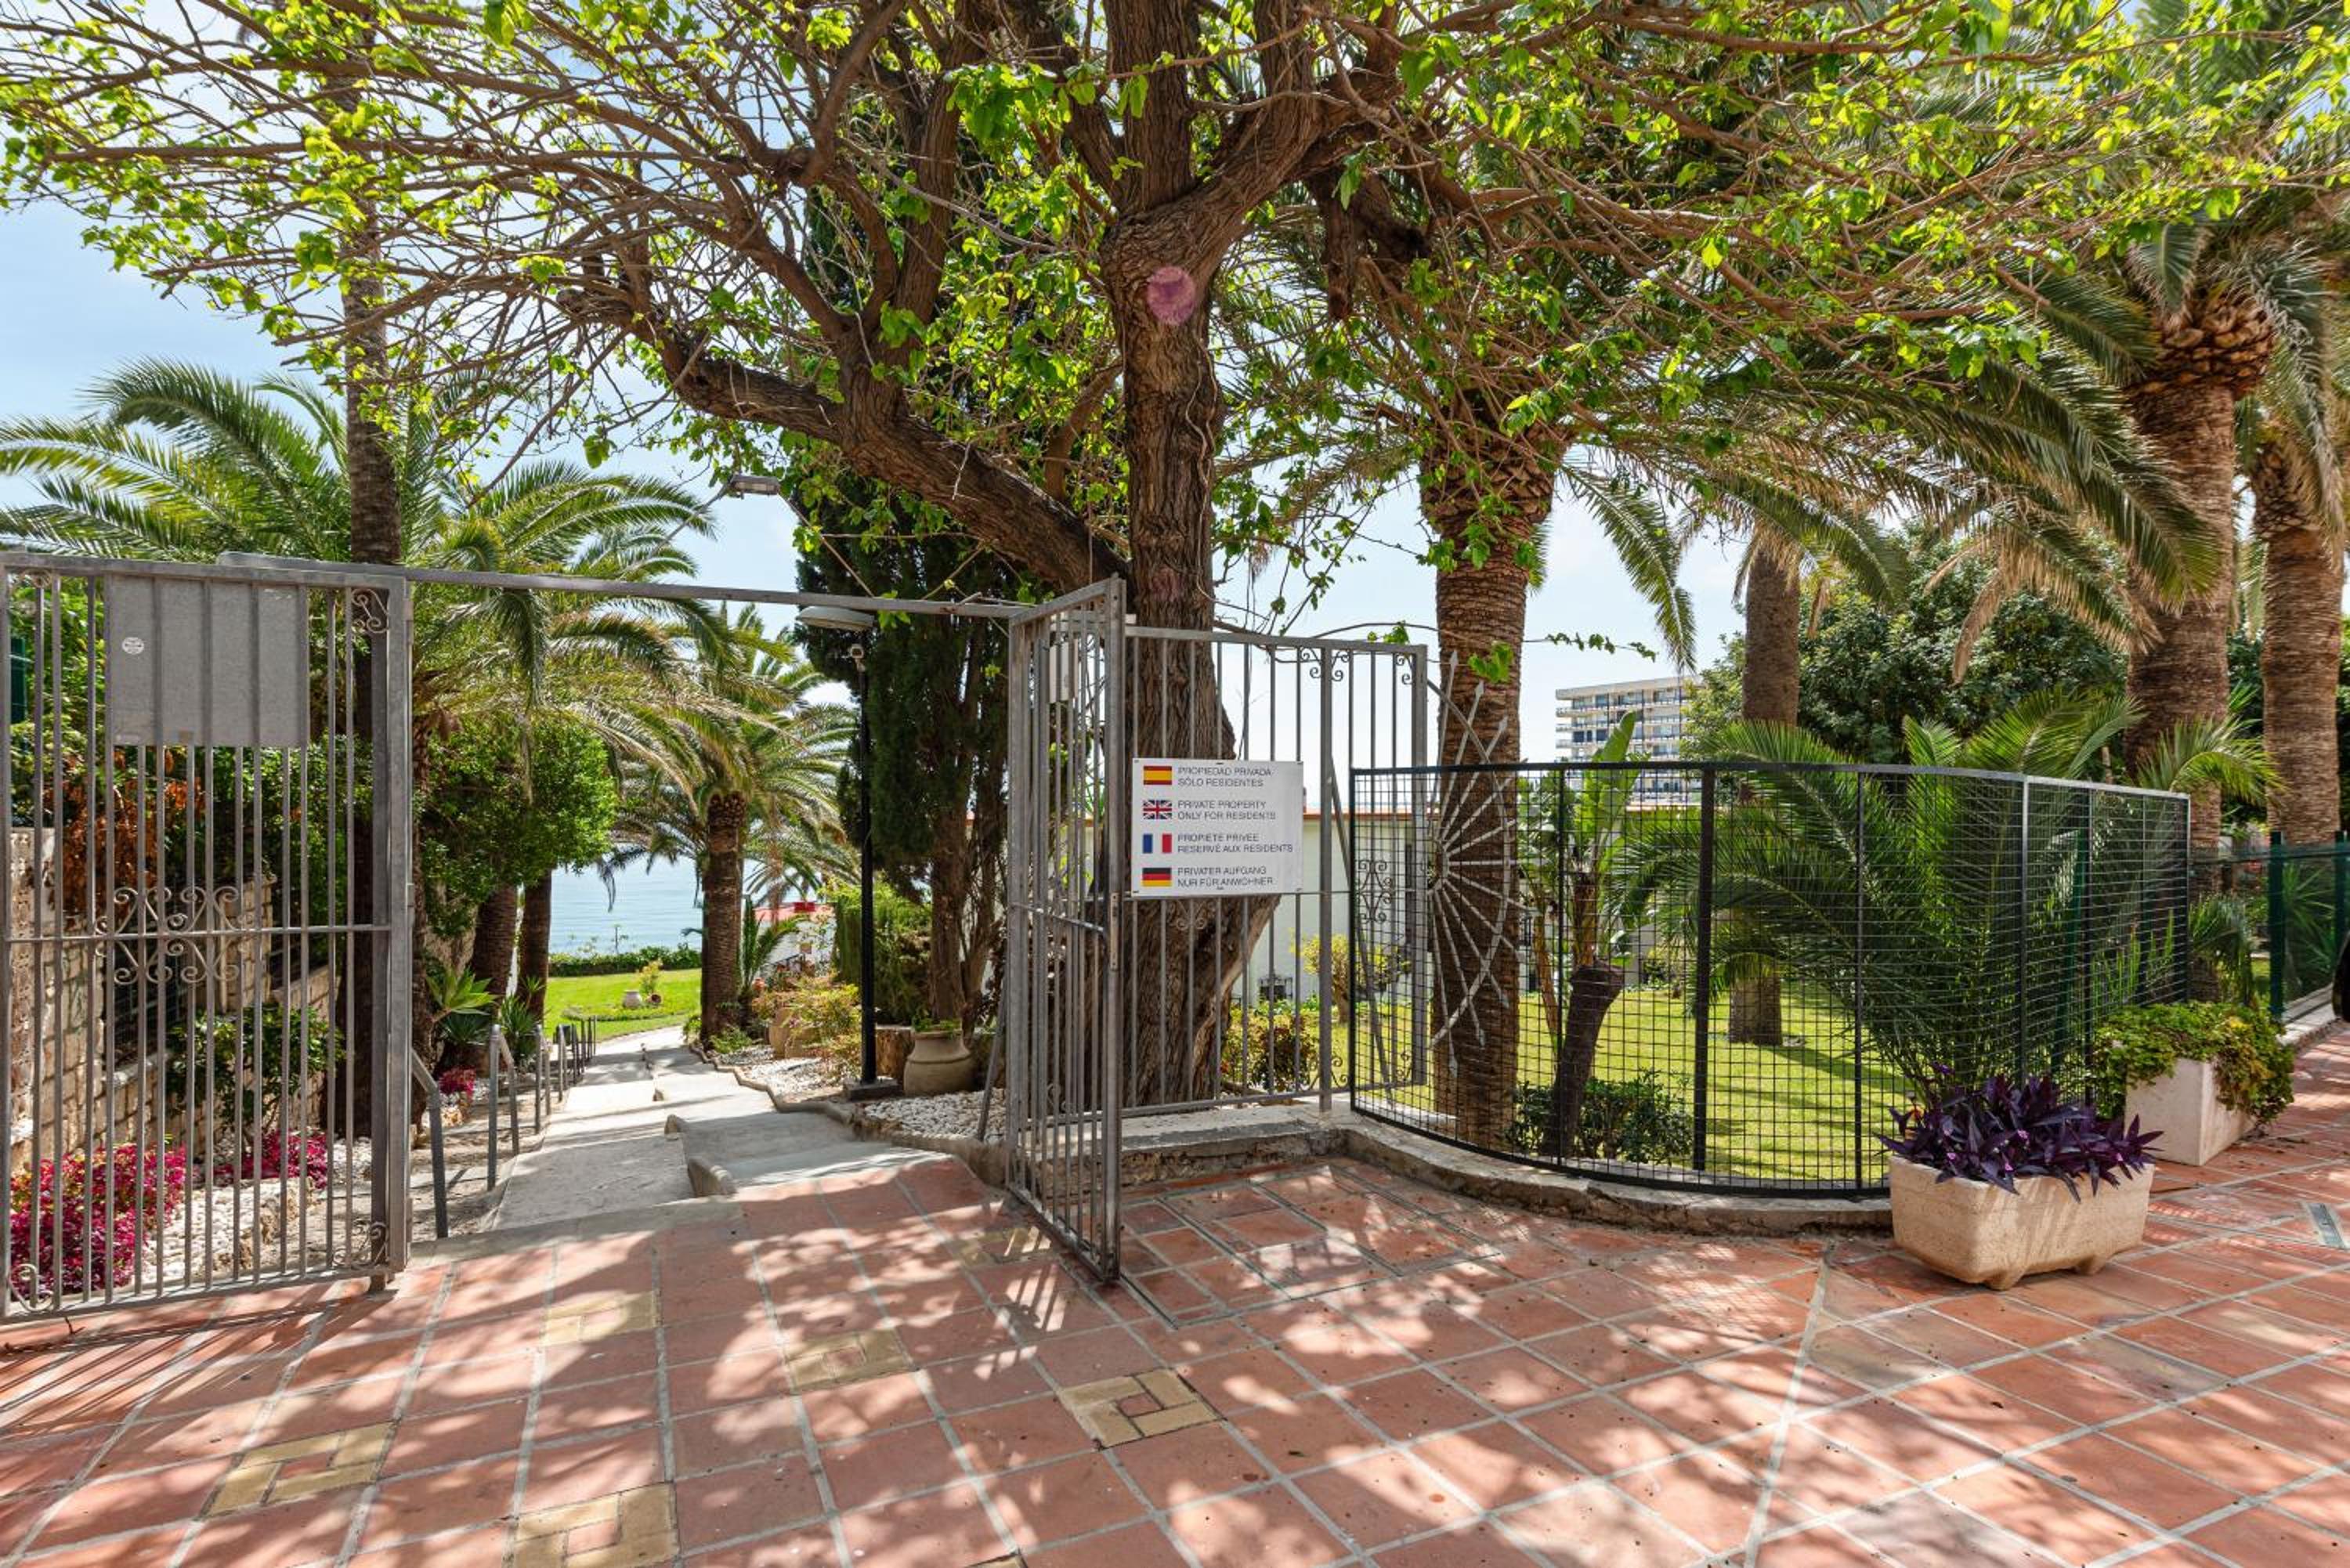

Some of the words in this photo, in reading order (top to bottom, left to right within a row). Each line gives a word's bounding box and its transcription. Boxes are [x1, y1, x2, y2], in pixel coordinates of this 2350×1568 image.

[1177, 766, 1232, 776] PROPIEDAD
[1234, 767, 1271, 776] PRIVADA
[1206, 778, 1264, 787] RESIDENTES
[1177, 800, 1215, 809] PRIVATE
[1218, 800, 1267, 809] PROPERTY
[1177, 811, 1202, 820] ONLY
[1204, 811, 1223, 820] FOR
[1226, 811, 1276, 820] RESIDENTS
[1223, 844, 1242, 853] AUX
[1243, 844, 1293, 853] RESIDENTS
[1177, 867, 1221, 876] PRIVATER
[1223, 866, 1267, 876] AUFGANG
[1177, 878, 1198, 887] NUR
[1199, 877, 1219, 887] FÜR
[1220, 877, 1273, 887] ANWOHNER
